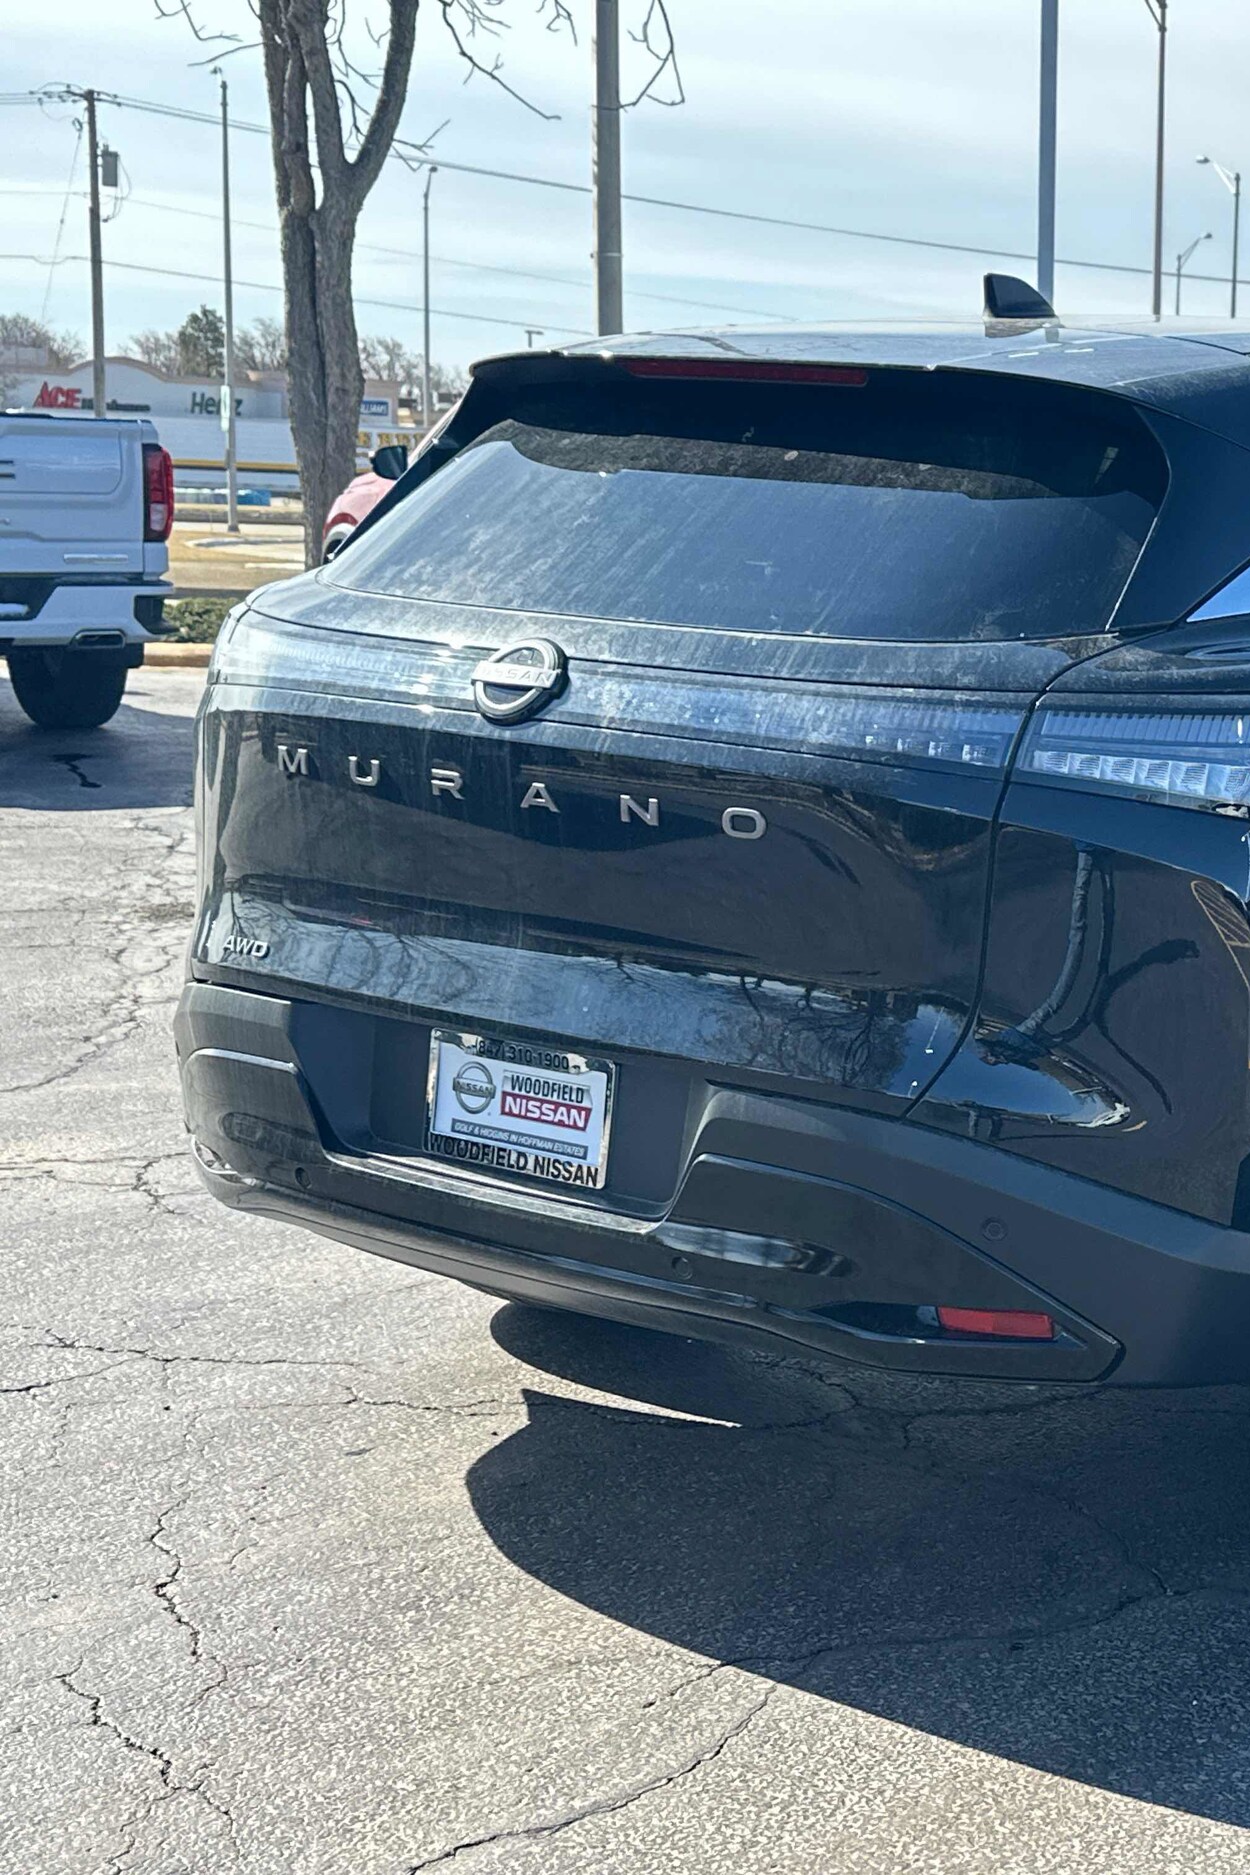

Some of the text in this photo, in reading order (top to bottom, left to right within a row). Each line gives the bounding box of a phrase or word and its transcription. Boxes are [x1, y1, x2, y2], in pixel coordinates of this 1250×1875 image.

[33, 381, 82, 409] ACE
[191, 391, 243, 417] Herz
[277, 745, 767, 839] MURANO
[223, 935, 268, 957] AWD
[508, 1044, 569, 1071] 310-1900
[511, 1074, 584, 1104] WOODFIELD
[504, 1098, 586, 1128] NISSAN
[454, 1122, 473, 1133] GOLF
[480, 1128, 509, 1141] HIGGINS
[517, 1135, 554, 1150] HOFFMAN
[553, 1142, 585, 1157] ESTATES
[430, 1133, 599, 1187] WOODFIELD NISSAN
